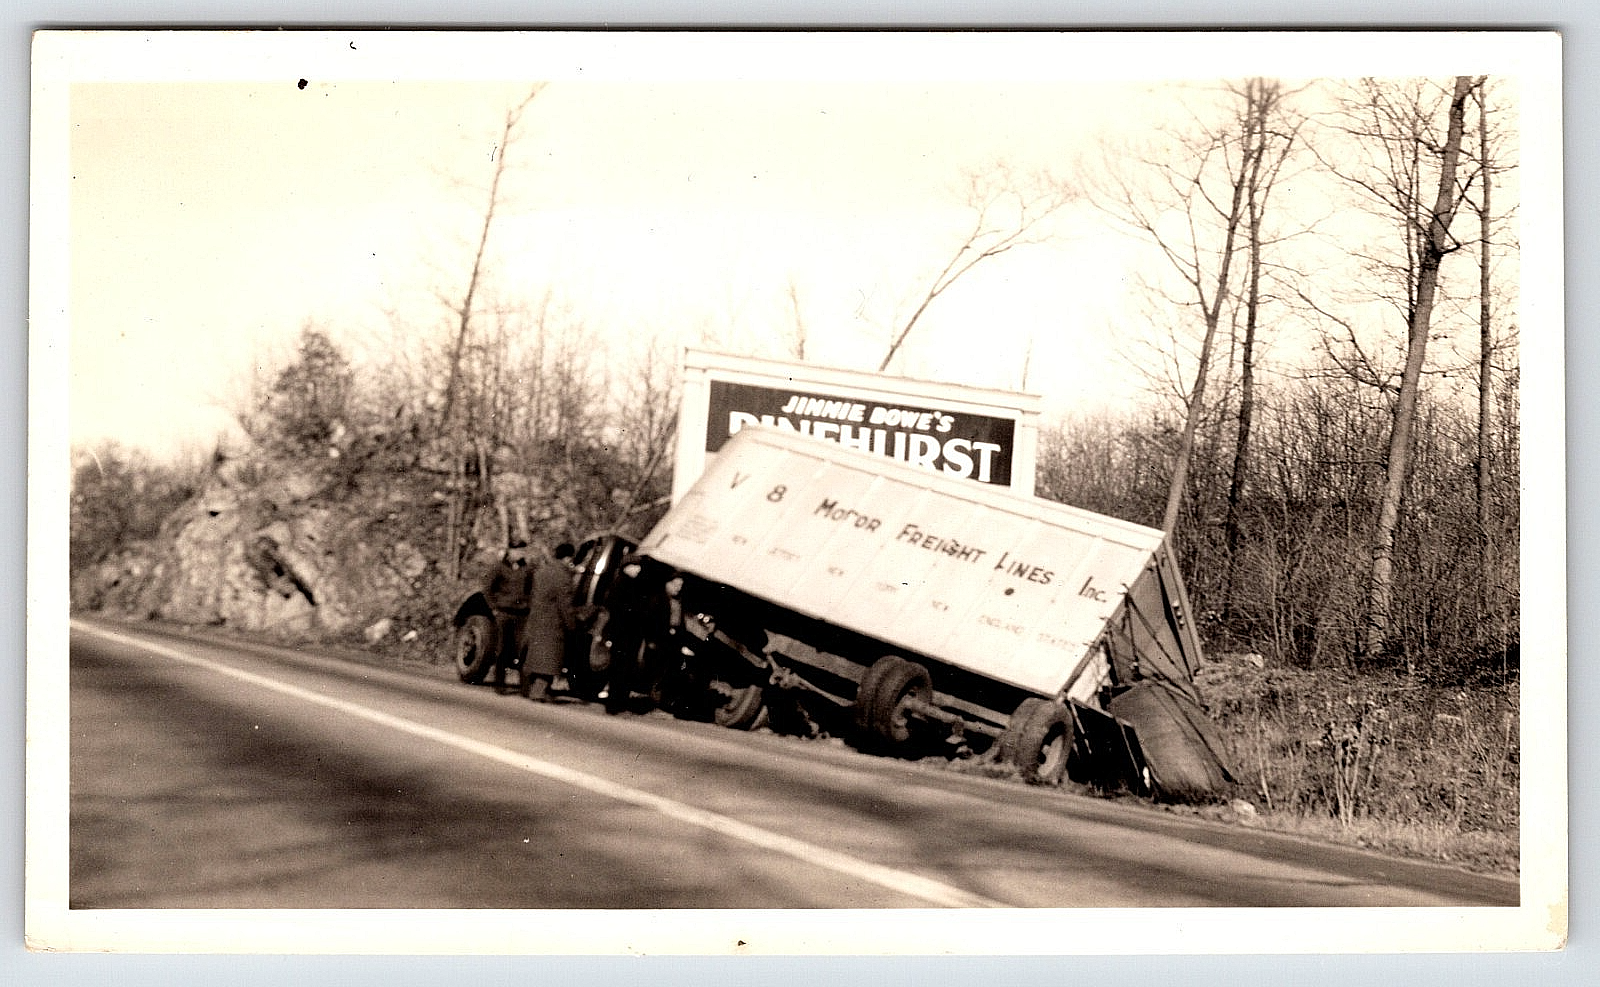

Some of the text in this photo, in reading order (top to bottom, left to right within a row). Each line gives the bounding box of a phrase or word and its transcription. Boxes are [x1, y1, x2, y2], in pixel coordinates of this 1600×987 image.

[781, 395, 866, 422] JIMMIE
[728, 410, 1002, 483] PEHURST
[730, 471, 1107, 603] V 8 MOTOR FREIGHT LINES Inc.
